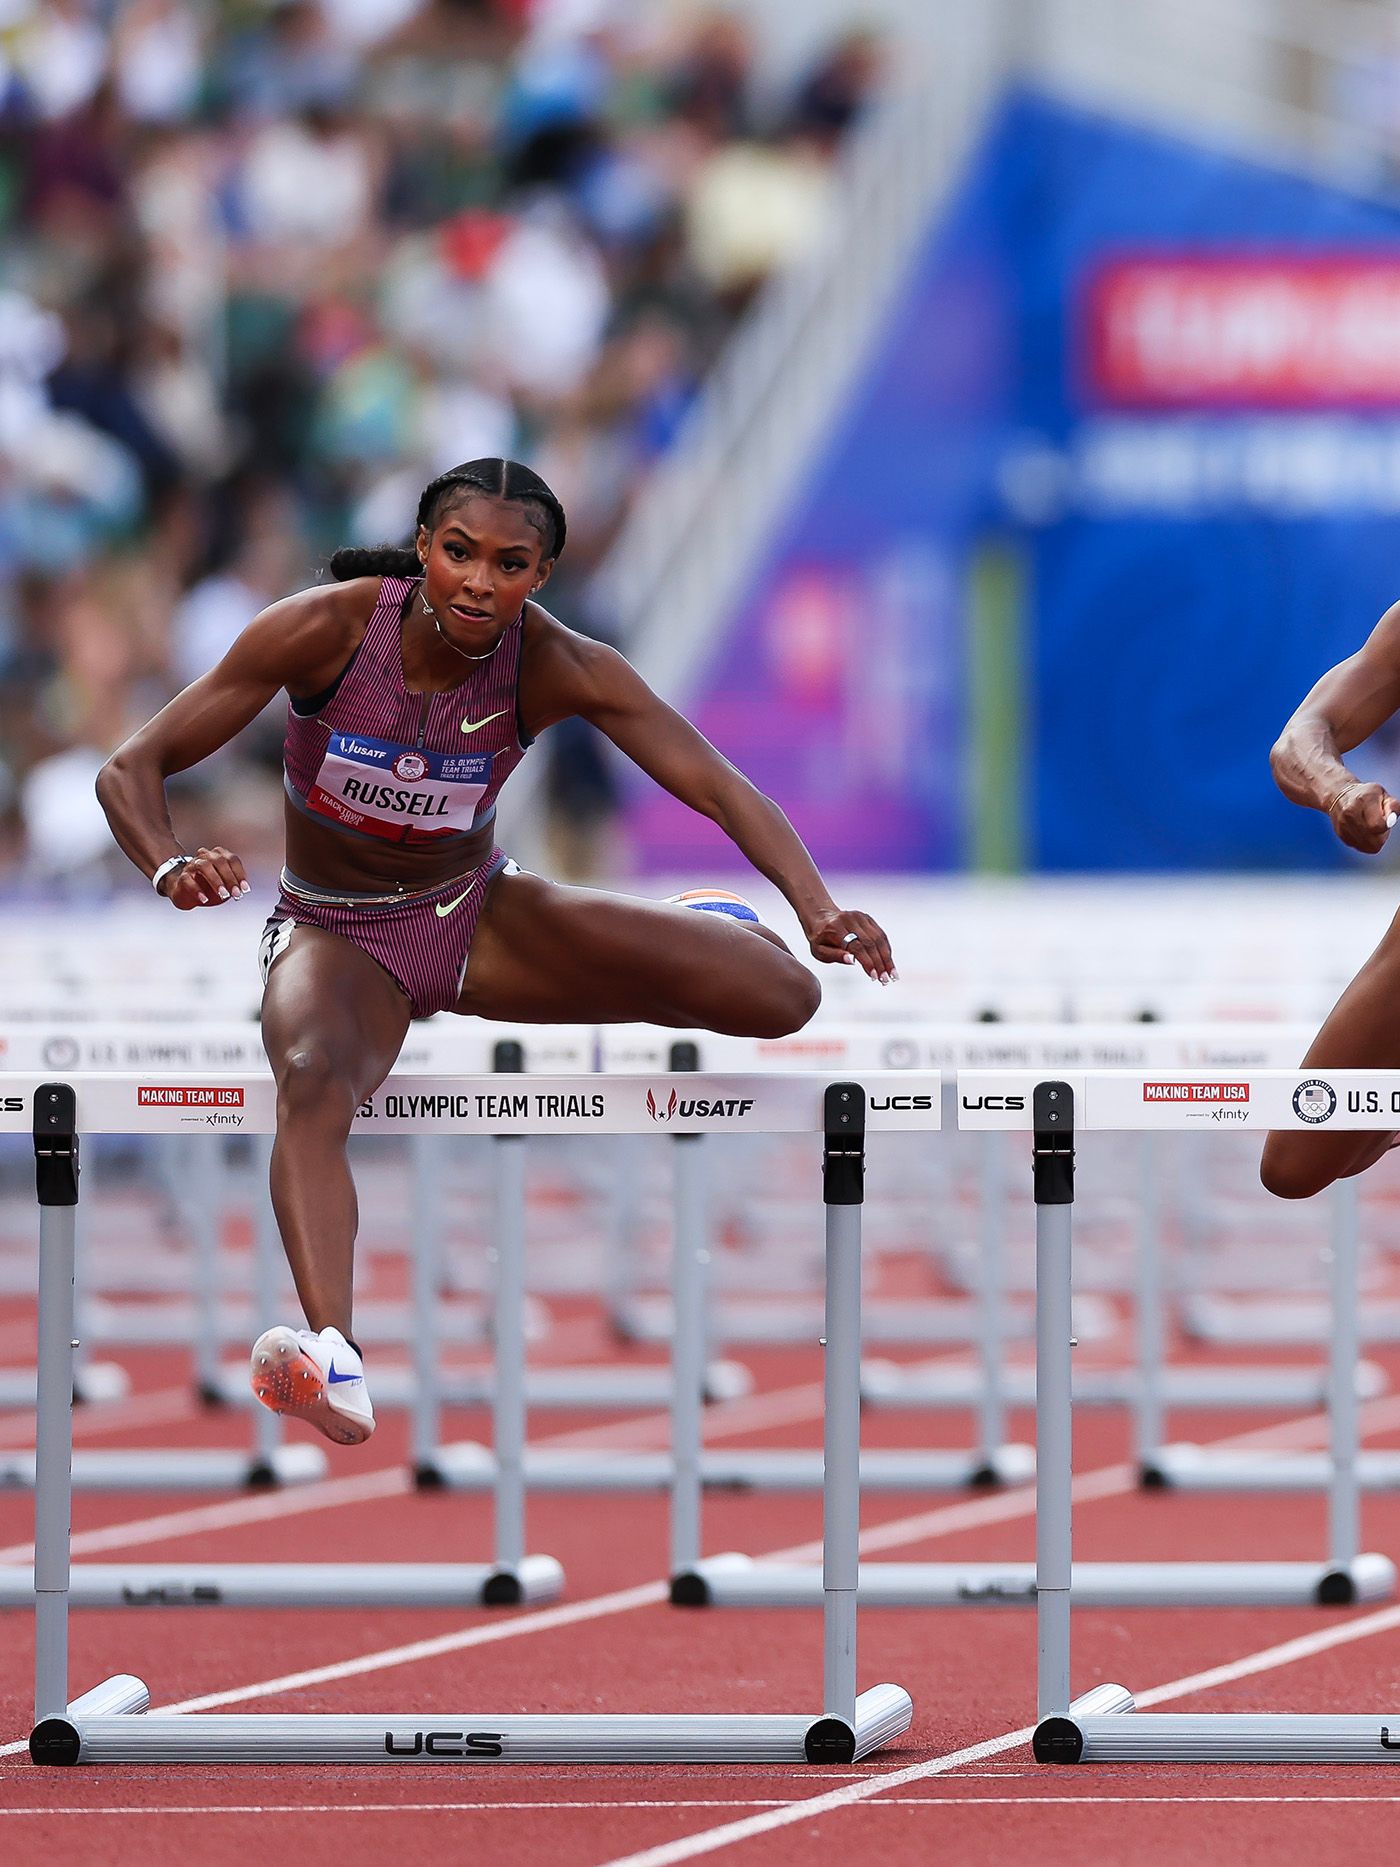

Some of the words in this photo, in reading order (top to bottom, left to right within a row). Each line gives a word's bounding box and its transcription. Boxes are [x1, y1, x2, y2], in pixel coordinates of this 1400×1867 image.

[353, 744, 387, 759] USATF
[457, 757, 487, 766] OLYMPIC
[441, 766, 460, 774] TEAM
[460, 765, 485, 773] TRIALS
[342, 777, 450, 817] RUSSELL
[141, 1090, 183, 1103] MAKING
[186, 1091, 214, 1103] TEAM
[217, 1091, 240, 1104] USA
[1146, 1086, 1189, 1099] MAKING
[1191, 1086, 1220, 1099] TEAM
[1223, 1087, 1246, 1099] USA
[385, 1095, 468, 1118] OLYMPIC
[475, 1095, 528, 1118] TEAM
[535, 1095, 604, 1118] TRIALS
[679, 1099, 755, 1117] USATF
[869, 1096, 933, 1111] UCS
[962, 1096, 1026, 1111] UCS
[1348, 1091, 1384, 1113] U.S.
[205, 1112, 244, 1126] xfinity
[1211, 1108, 1250, 1122] xfinity
[385, 1732, 503, 1756] UCS
